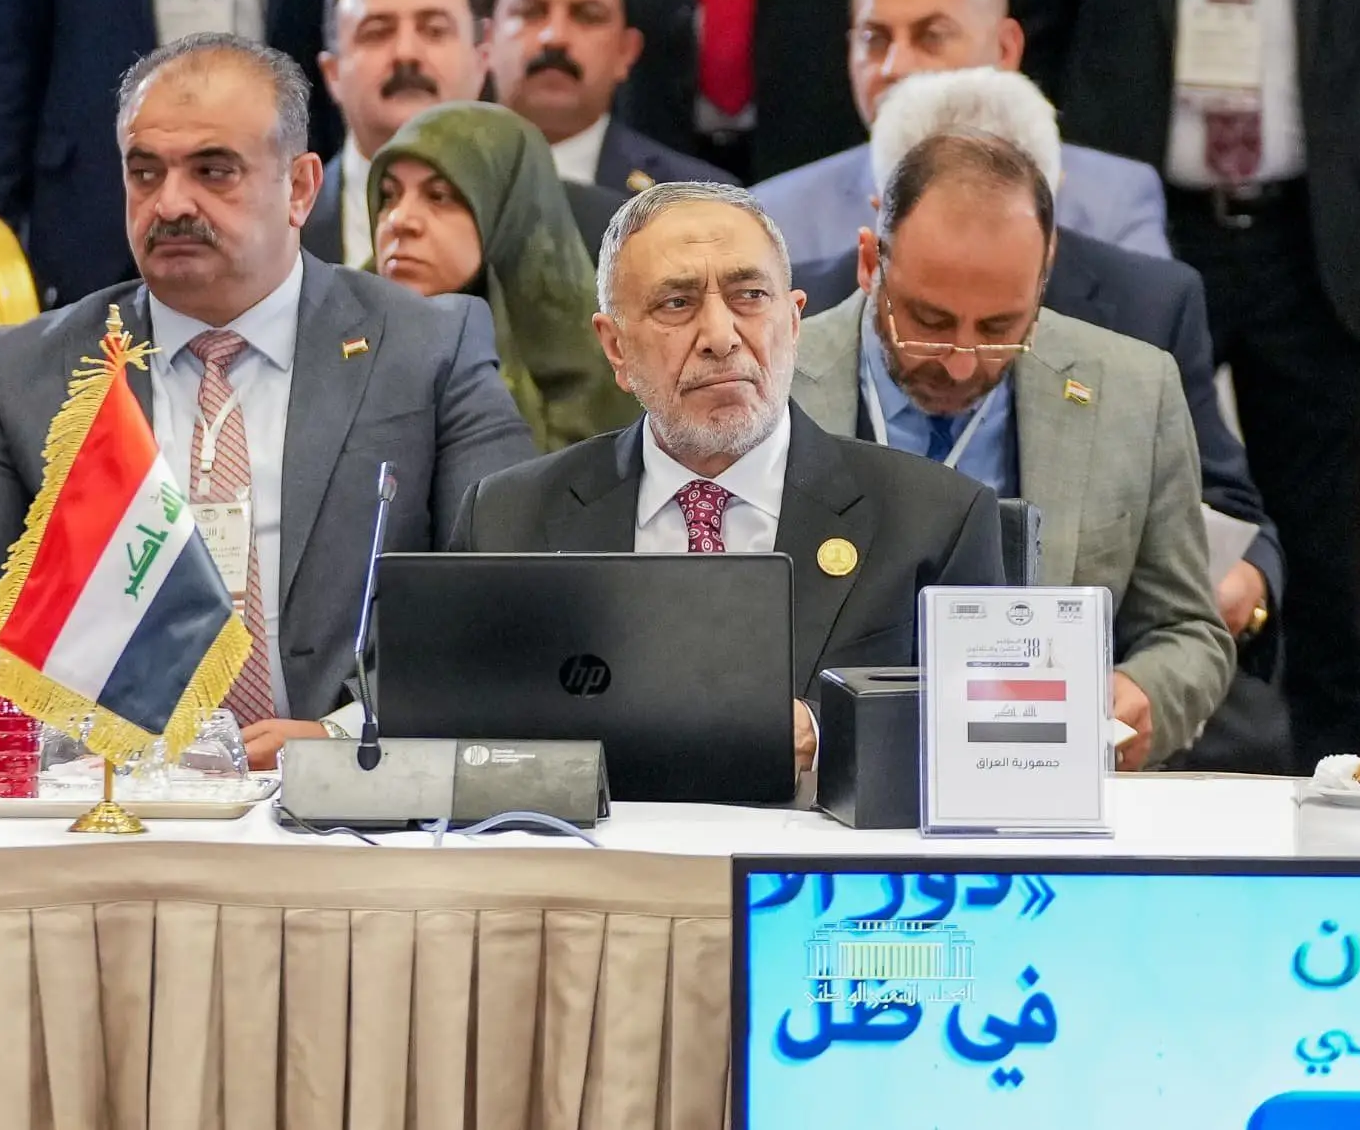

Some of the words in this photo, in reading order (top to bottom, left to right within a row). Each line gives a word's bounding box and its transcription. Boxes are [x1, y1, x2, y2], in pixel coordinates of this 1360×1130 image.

[565, 656, 606, 698] hp
[976, 757, 1009, 770] العراق
[1012, 757, 1060, 769] جمهورية
[946, 965, 1058, 1088] في
